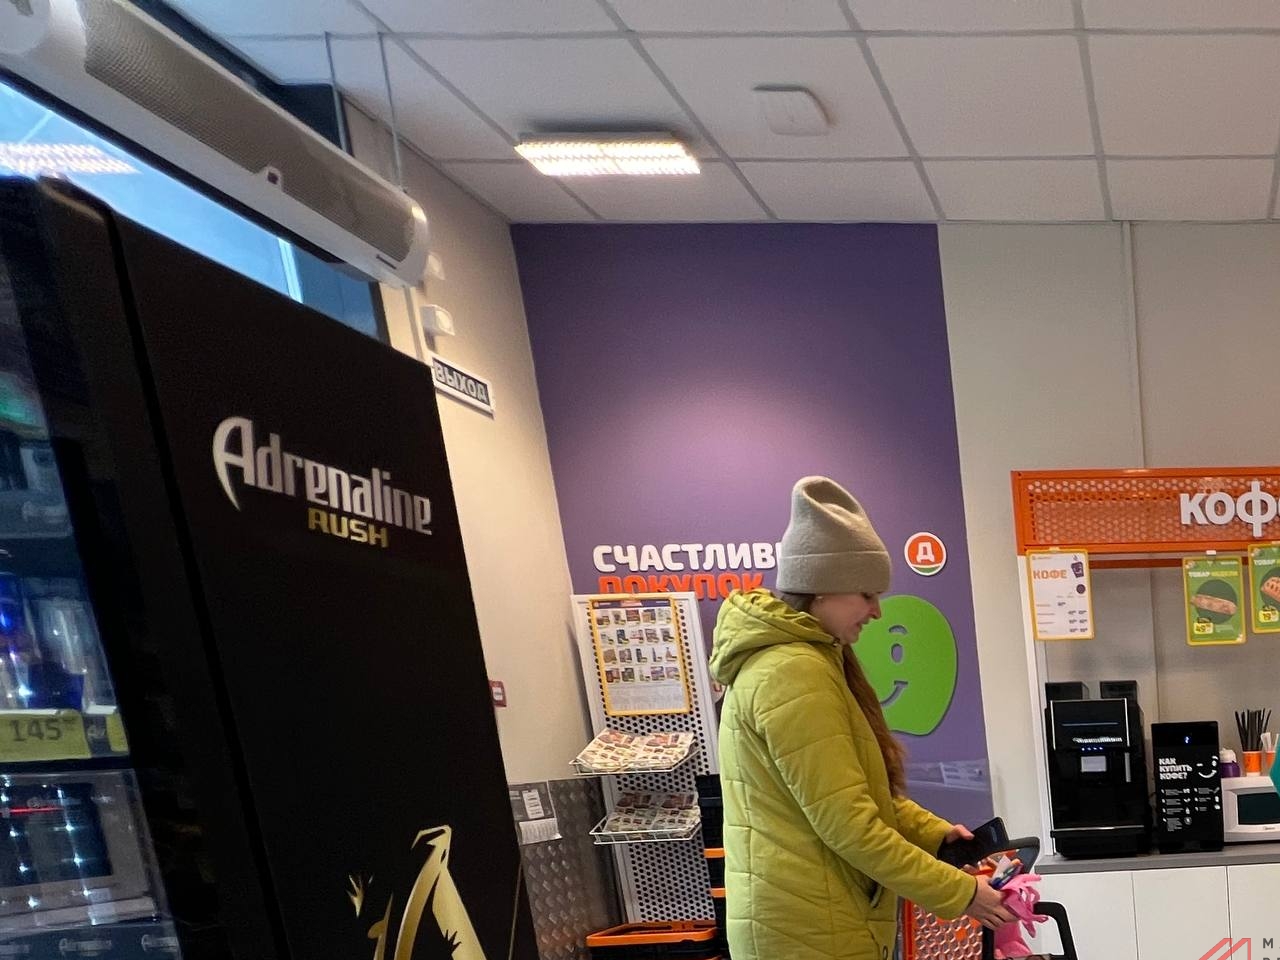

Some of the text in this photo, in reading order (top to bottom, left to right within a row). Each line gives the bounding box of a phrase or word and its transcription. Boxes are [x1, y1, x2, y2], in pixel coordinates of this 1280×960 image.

[432, 359, 490, 404] ВЫХОД
[213, 416, 433, 536] Adrenaline
[308, 507, 389, 548] RUSH
[593, 542, 782, 572] СЧАСТЛИВ
[599, 573, 763, 600] ПОКУПОК
[1033, 570, 1067, 579] КОФЕ
[10, 719, 62, 741] 145
[1159, 757, 1176, 765] КАК
[1159, 772, 1188, 780] КОФЕ?
